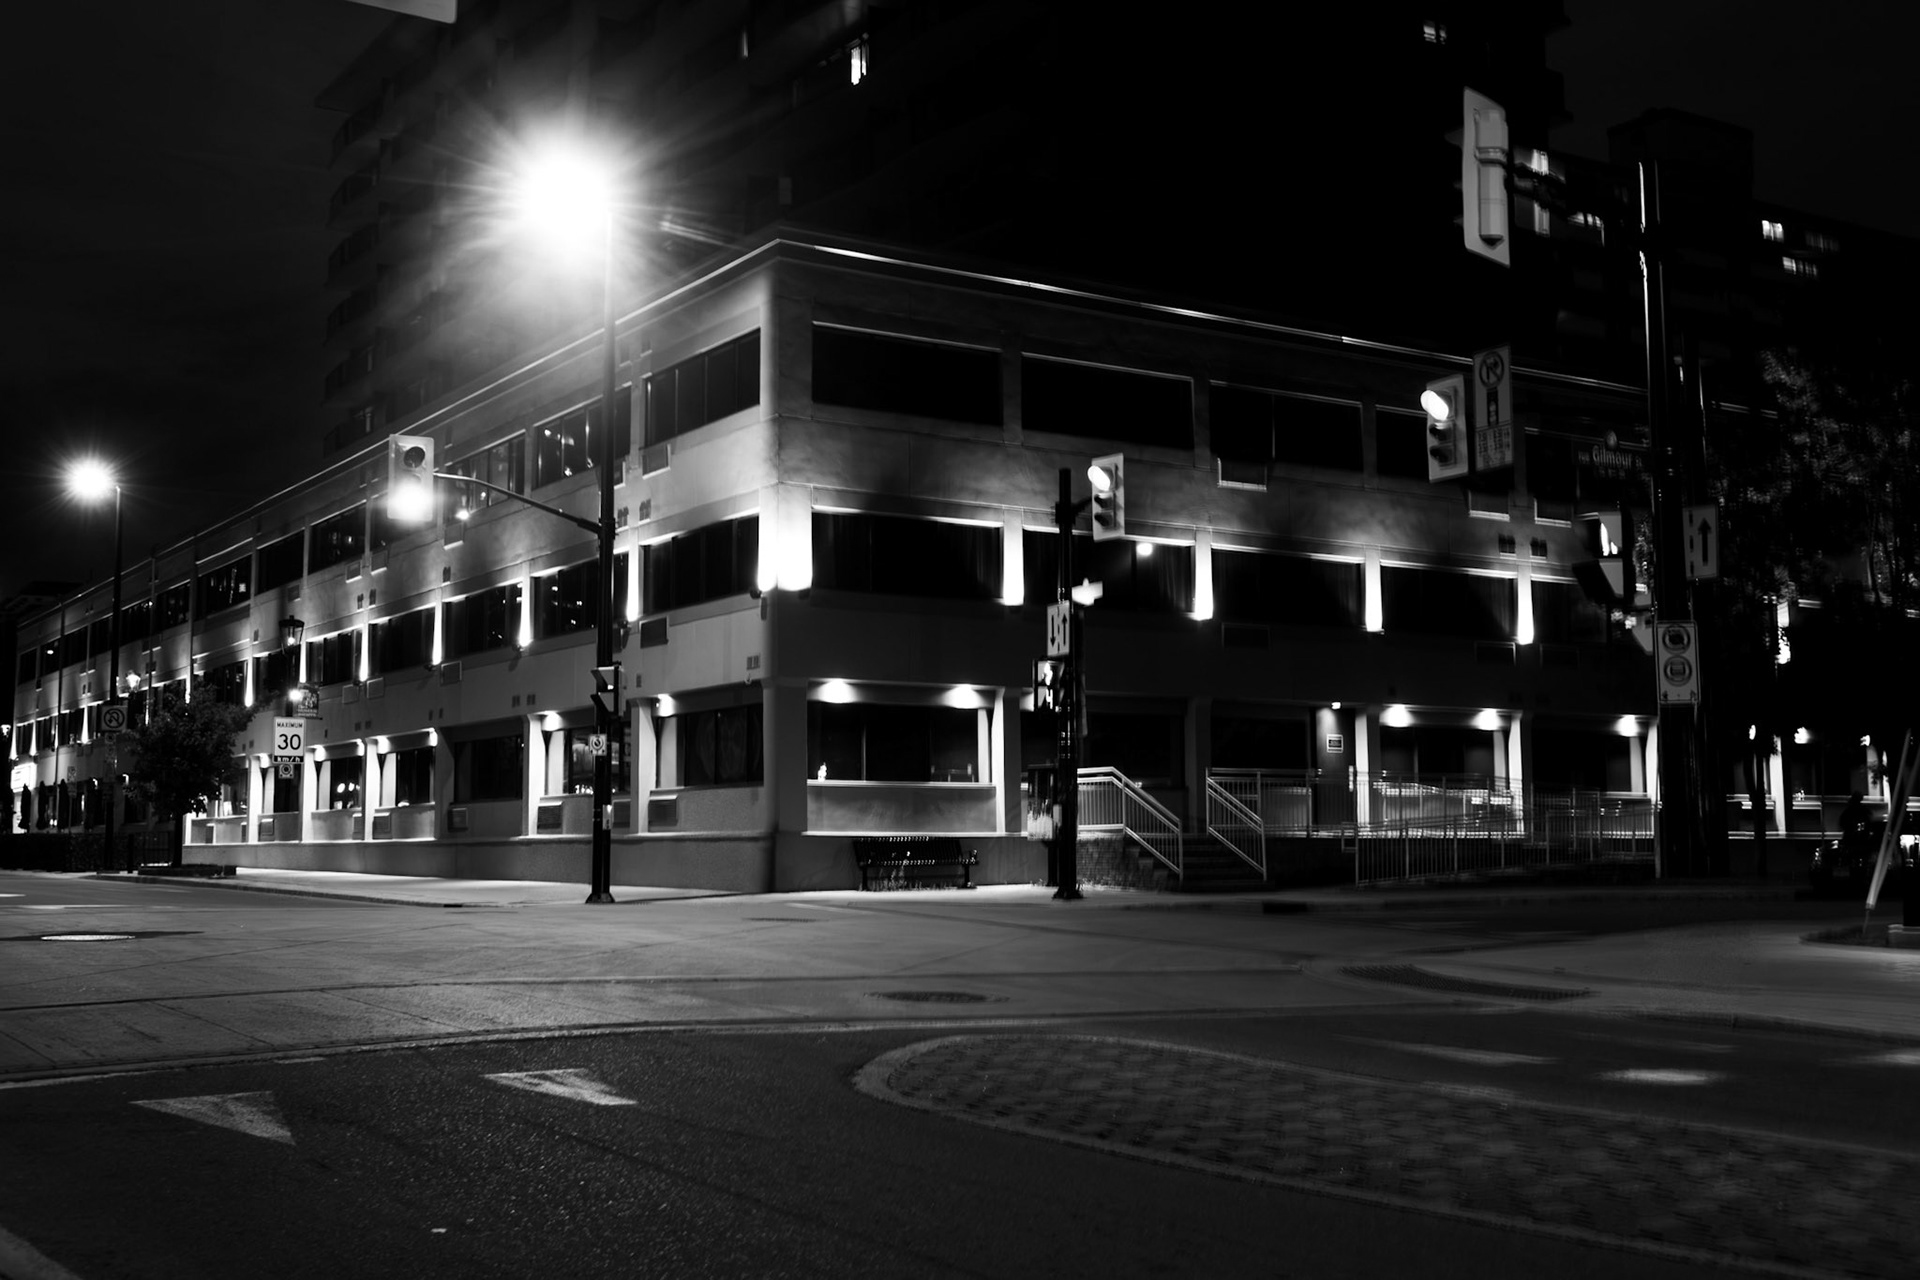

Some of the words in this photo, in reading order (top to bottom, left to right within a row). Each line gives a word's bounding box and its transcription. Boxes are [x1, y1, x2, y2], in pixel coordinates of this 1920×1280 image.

[1592, 445, 1632, 471] Gilmour
[276, 721, 303, 729] MAXIMUM
[277, 734, 301, 751] 30
[277, 755, 302, 764] km/h
